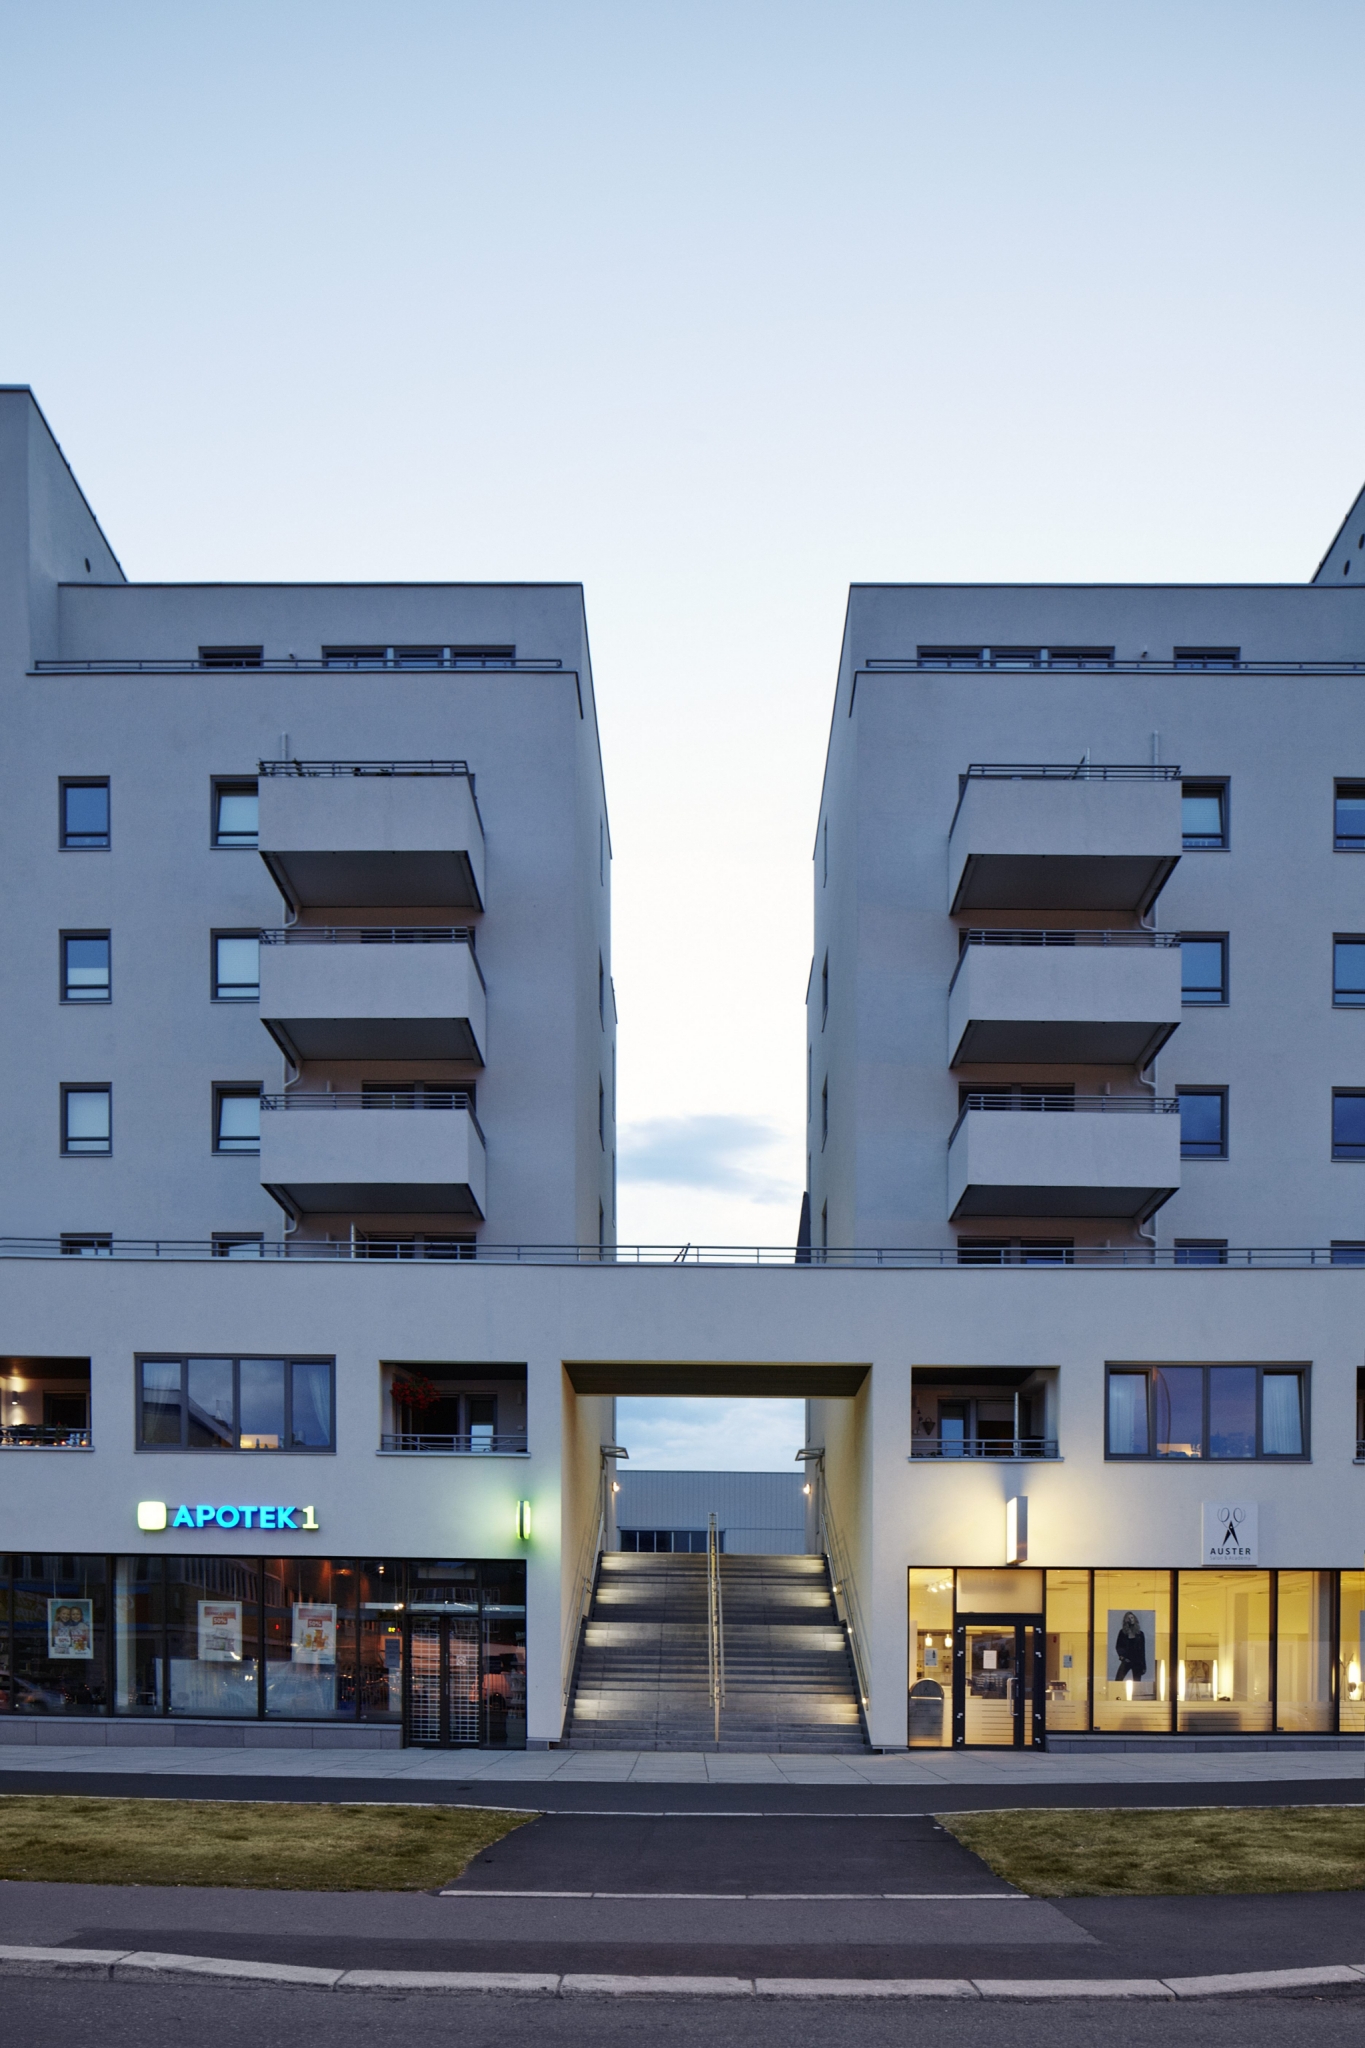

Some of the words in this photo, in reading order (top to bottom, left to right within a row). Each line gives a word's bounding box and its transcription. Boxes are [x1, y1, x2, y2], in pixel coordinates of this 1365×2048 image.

[172, 1504, 298, 1529] APOTEK
[302, 1505, 319, 1529] 1
[1210, 1547, 1251, 1555] AUSTER
